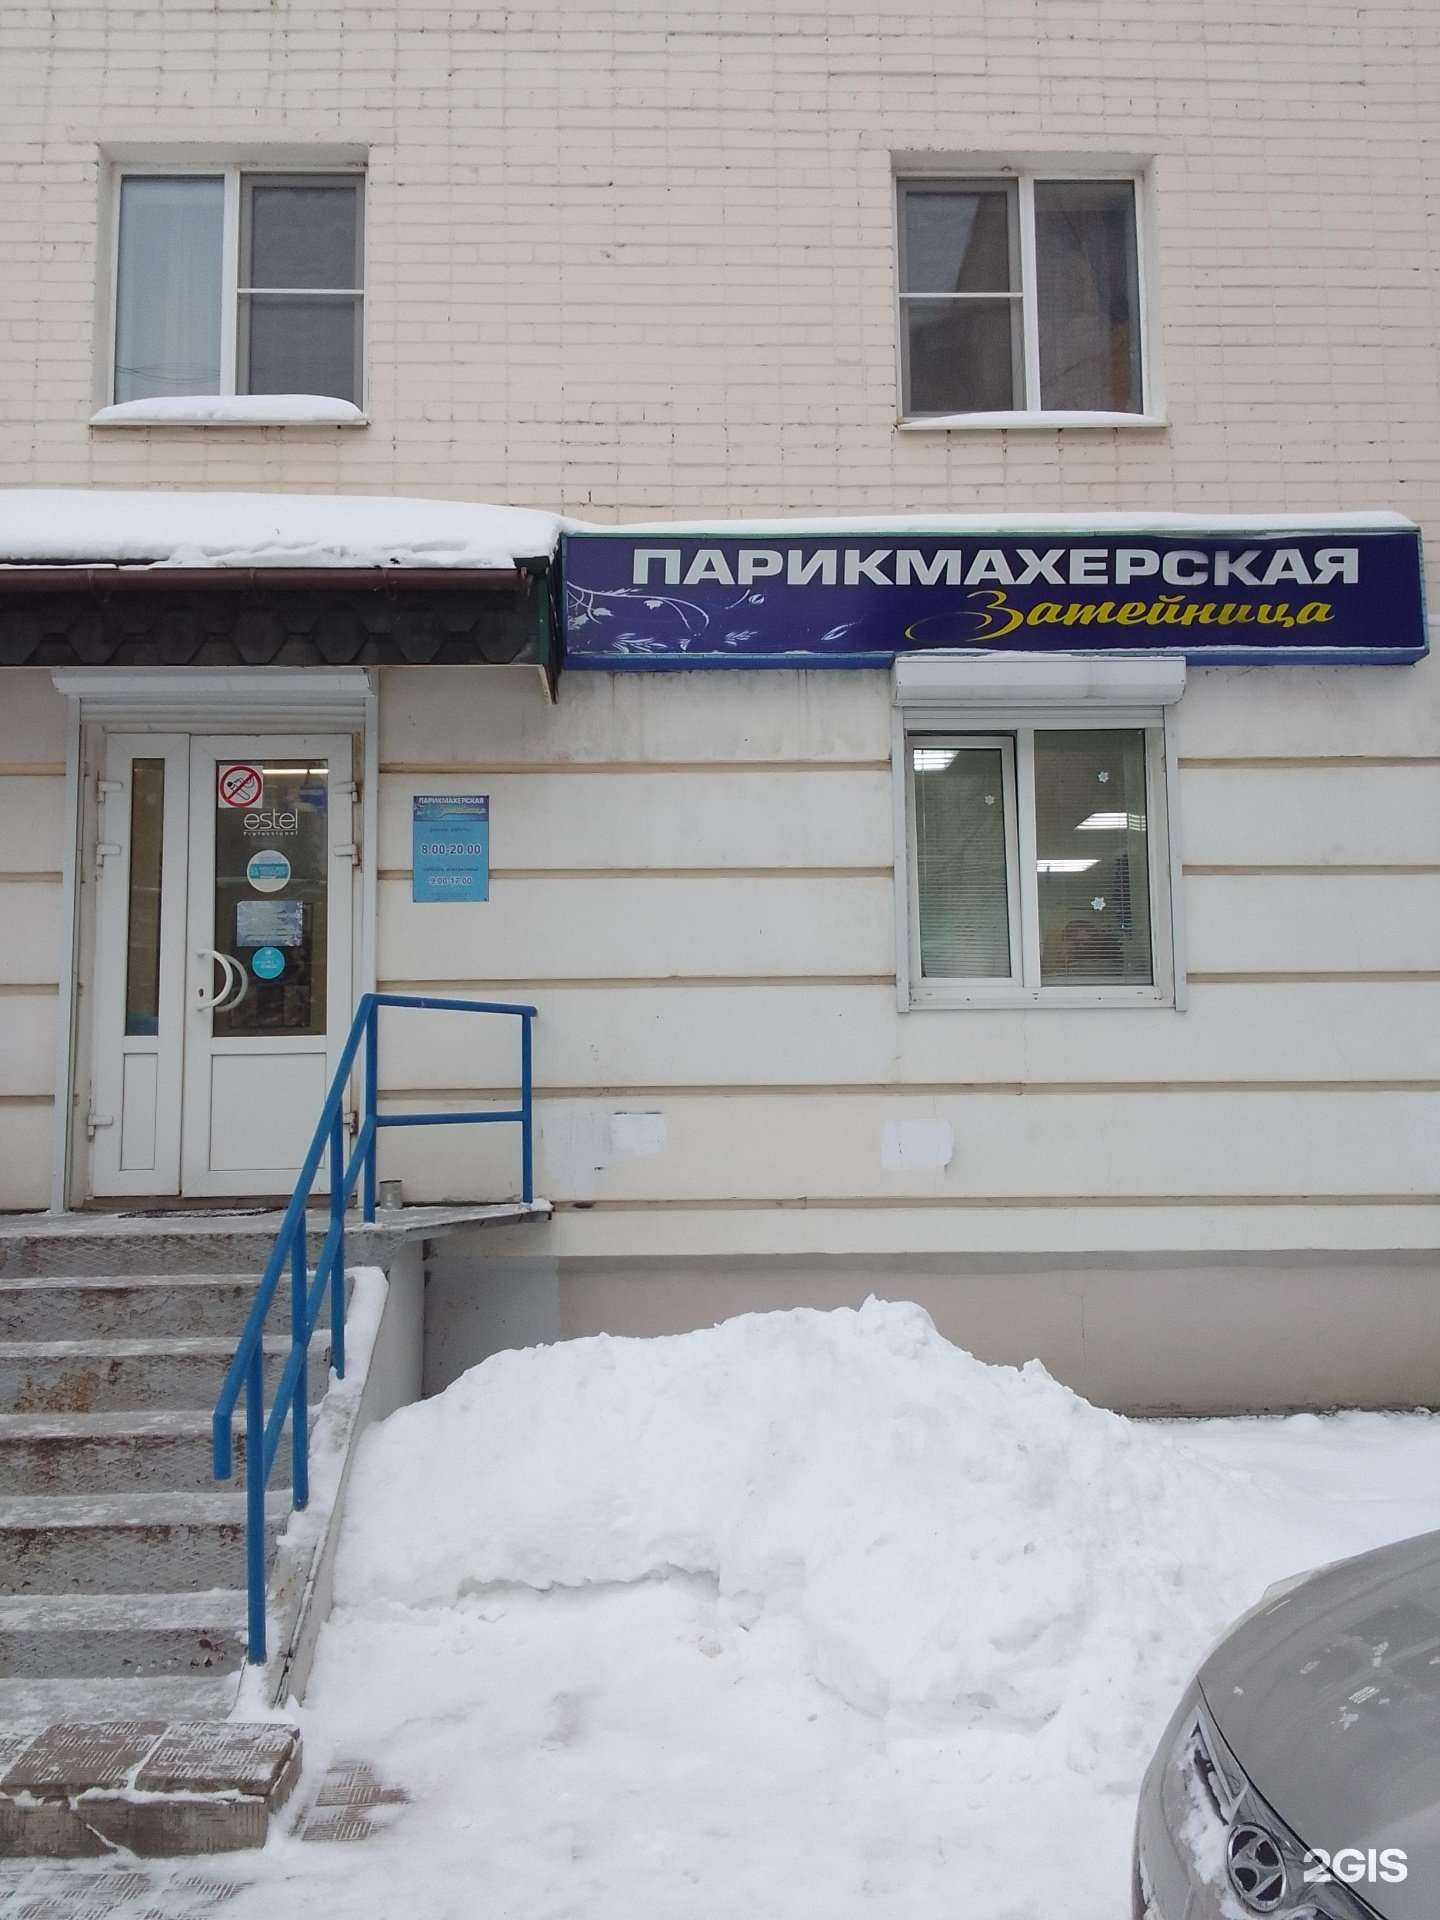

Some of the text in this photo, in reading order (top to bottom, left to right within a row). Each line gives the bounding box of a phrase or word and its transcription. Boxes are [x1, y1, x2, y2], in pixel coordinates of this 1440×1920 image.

[632, 548, 1359, 586] ПАРИКМАХЕРСКАЯ
[905, 590, 1335, 642] Затейница
[243, 807, 298, 830] estel
